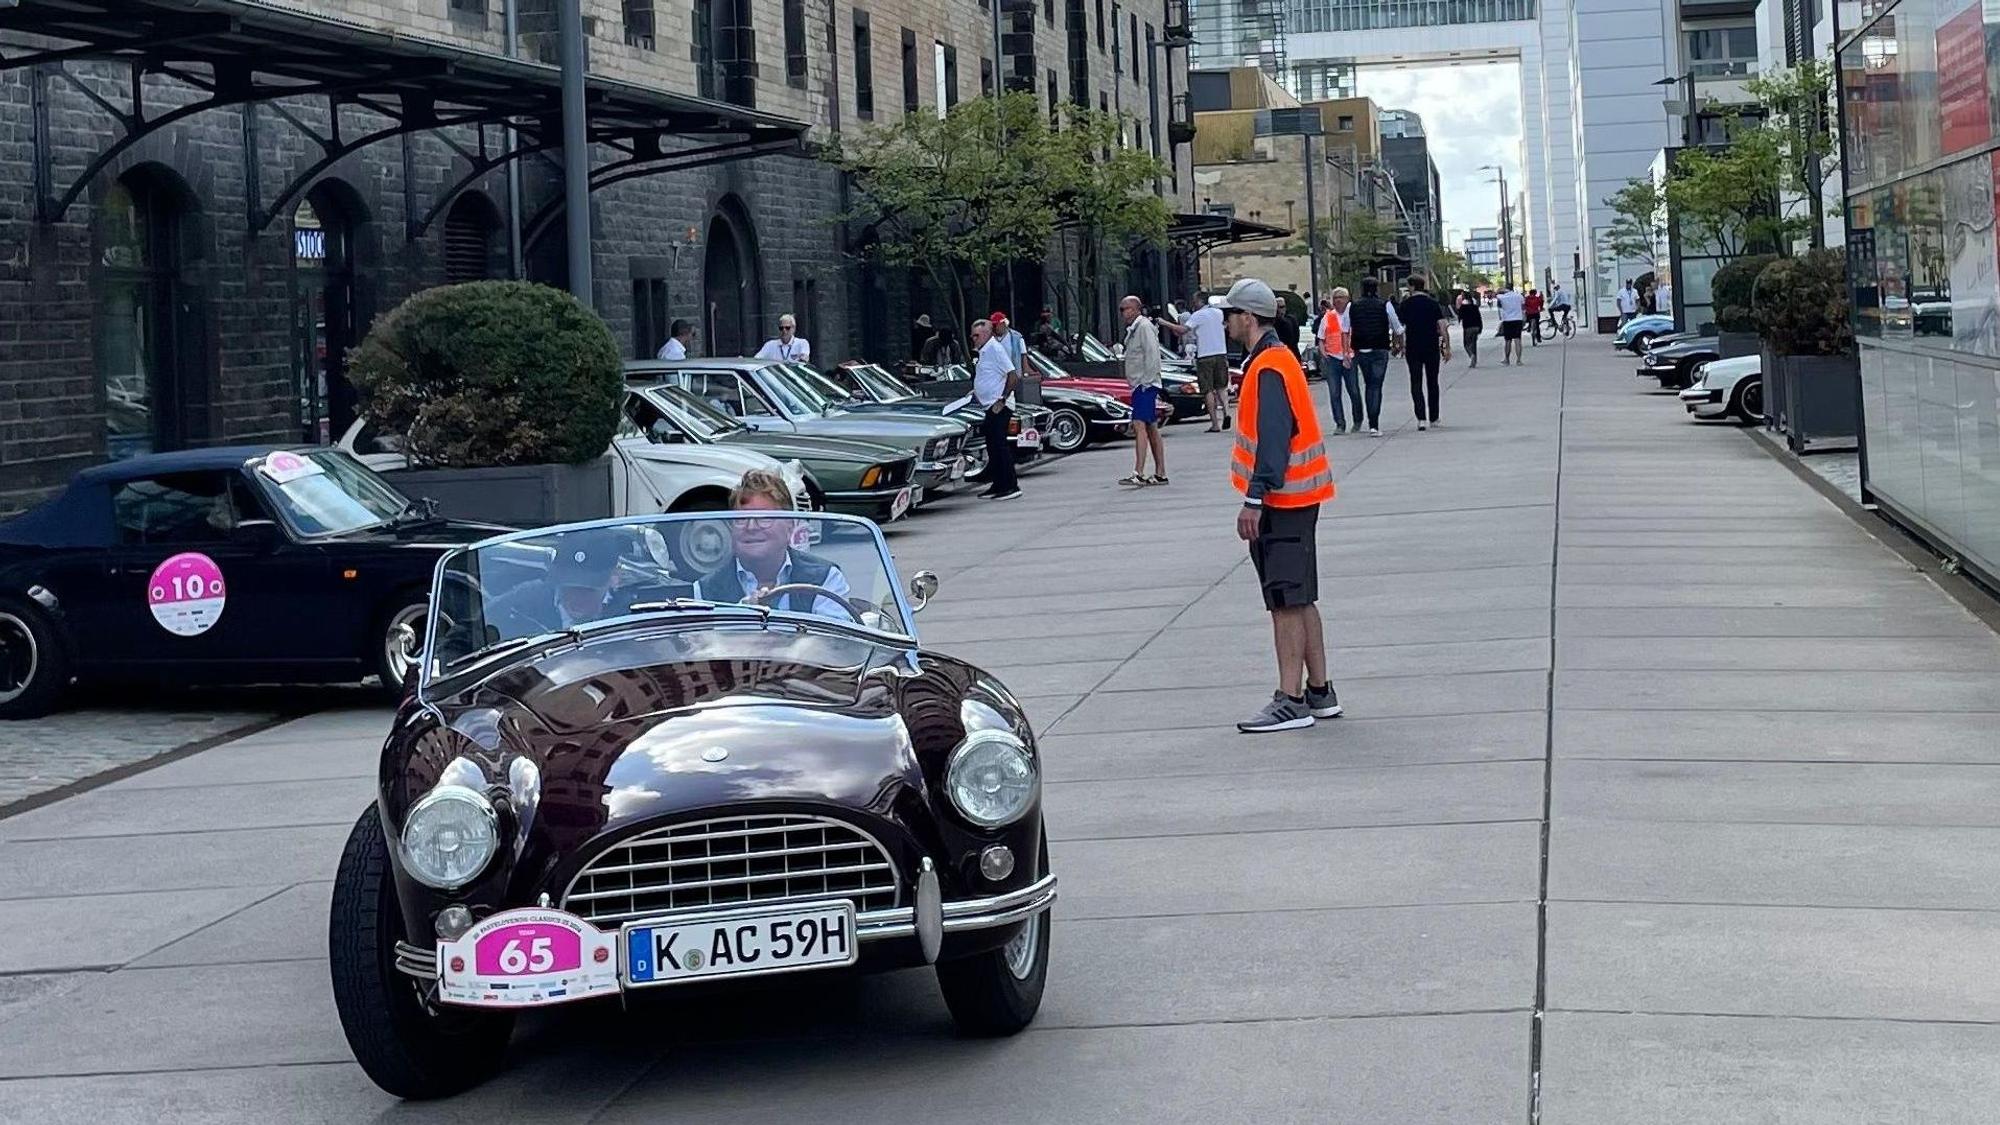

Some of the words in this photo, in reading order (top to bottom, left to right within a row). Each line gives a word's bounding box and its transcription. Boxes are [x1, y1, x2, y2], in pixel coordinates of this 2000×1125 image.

[172, 574, 204, 600] 10
[499, 937, 554, 974] 65
[655, 932, 681, 971] K
[710, 925, 761, 967] AC
[770, 915, 847, 959] 59H
[637, 960, 647, 971] D
